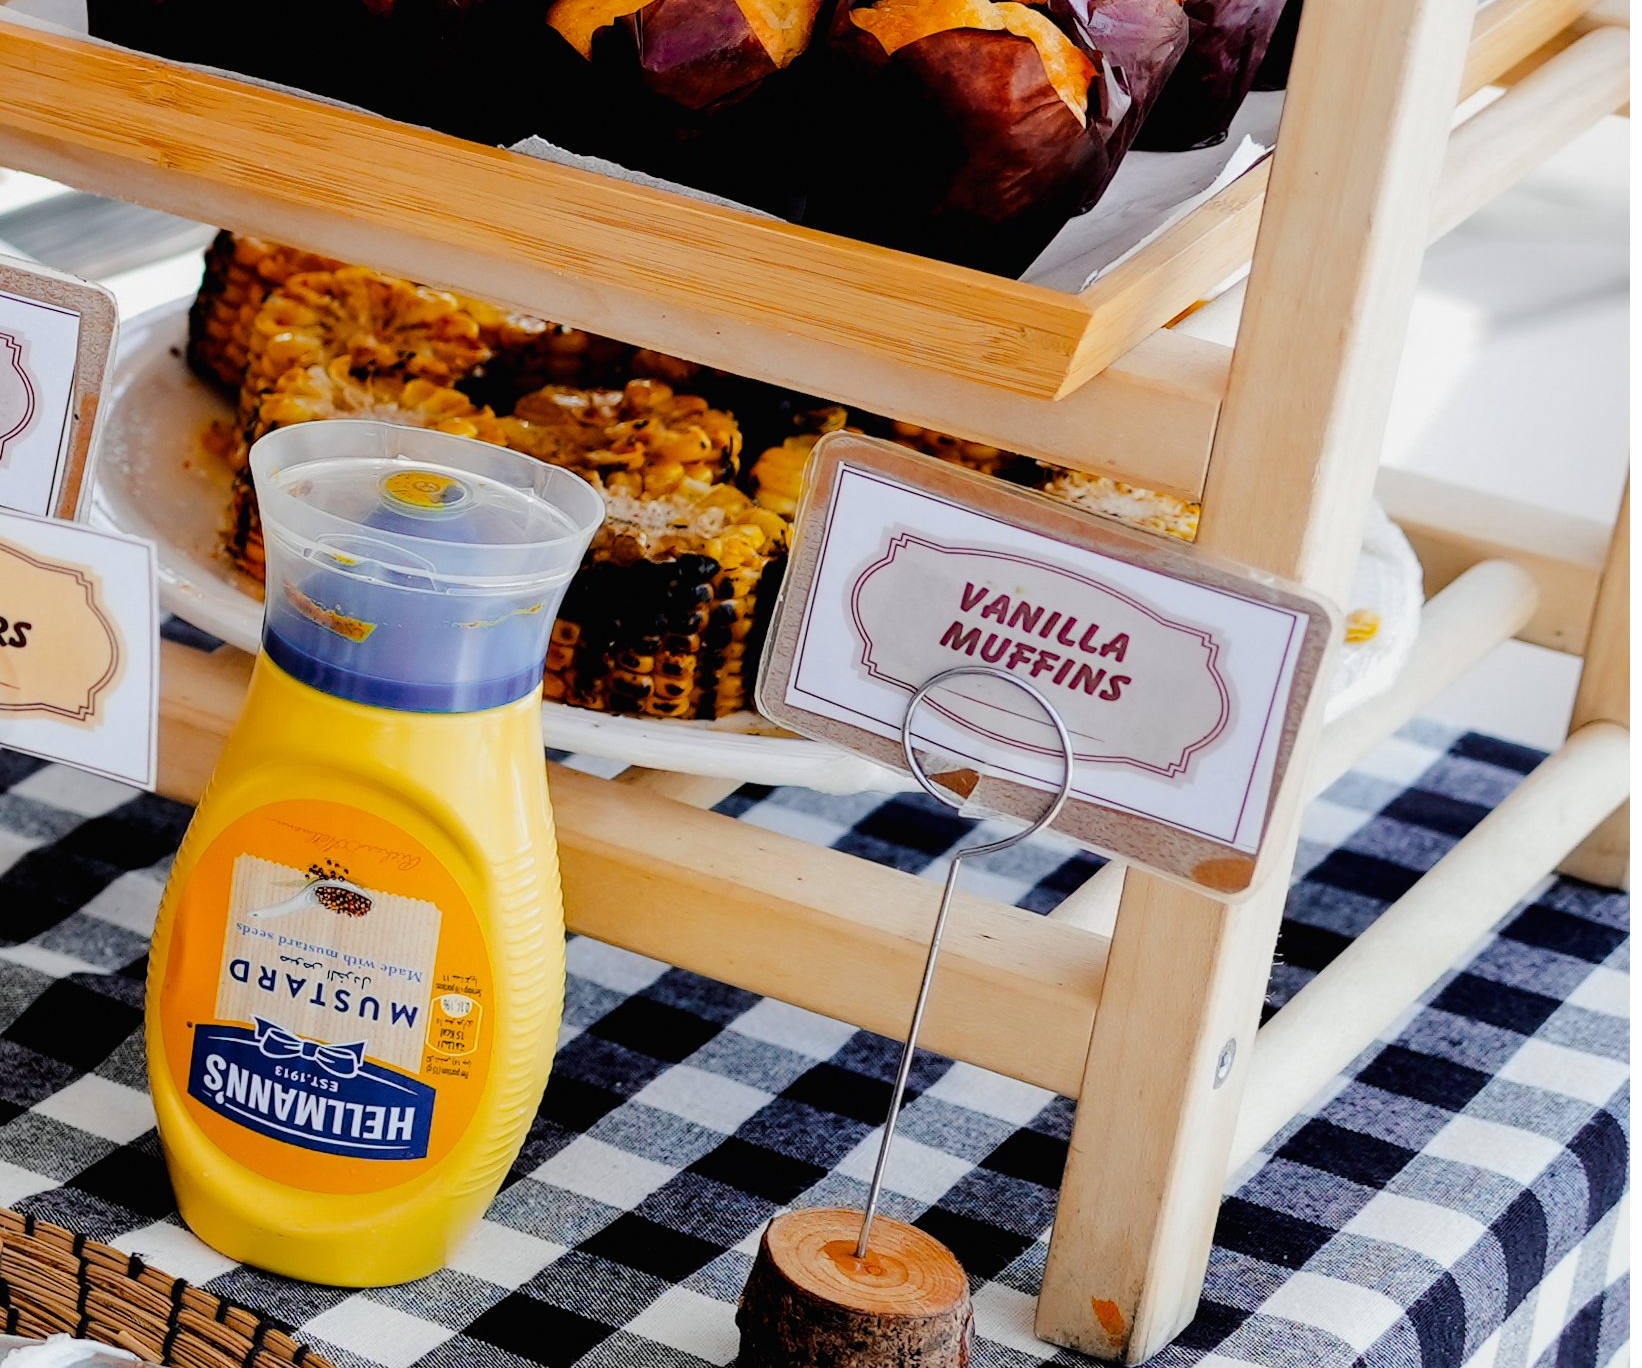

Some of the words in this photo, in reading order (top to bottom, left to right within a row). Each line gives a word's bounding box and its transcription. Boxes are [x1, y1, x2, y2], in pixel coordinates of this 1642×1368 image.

[960, 582, 1130, 662] VANILLA
[939, 620, 1132, 701] MUFFINS
[236, 922, 273, 939] seeds
[278, 935, 339, 959] mustard
[343, 954, 375, 969] with
[379, 963, 423, 983] Made
[229, 958, 419, 1028] MUSTARD
[203, 1053, 416, 1141] HELLMANN'S
